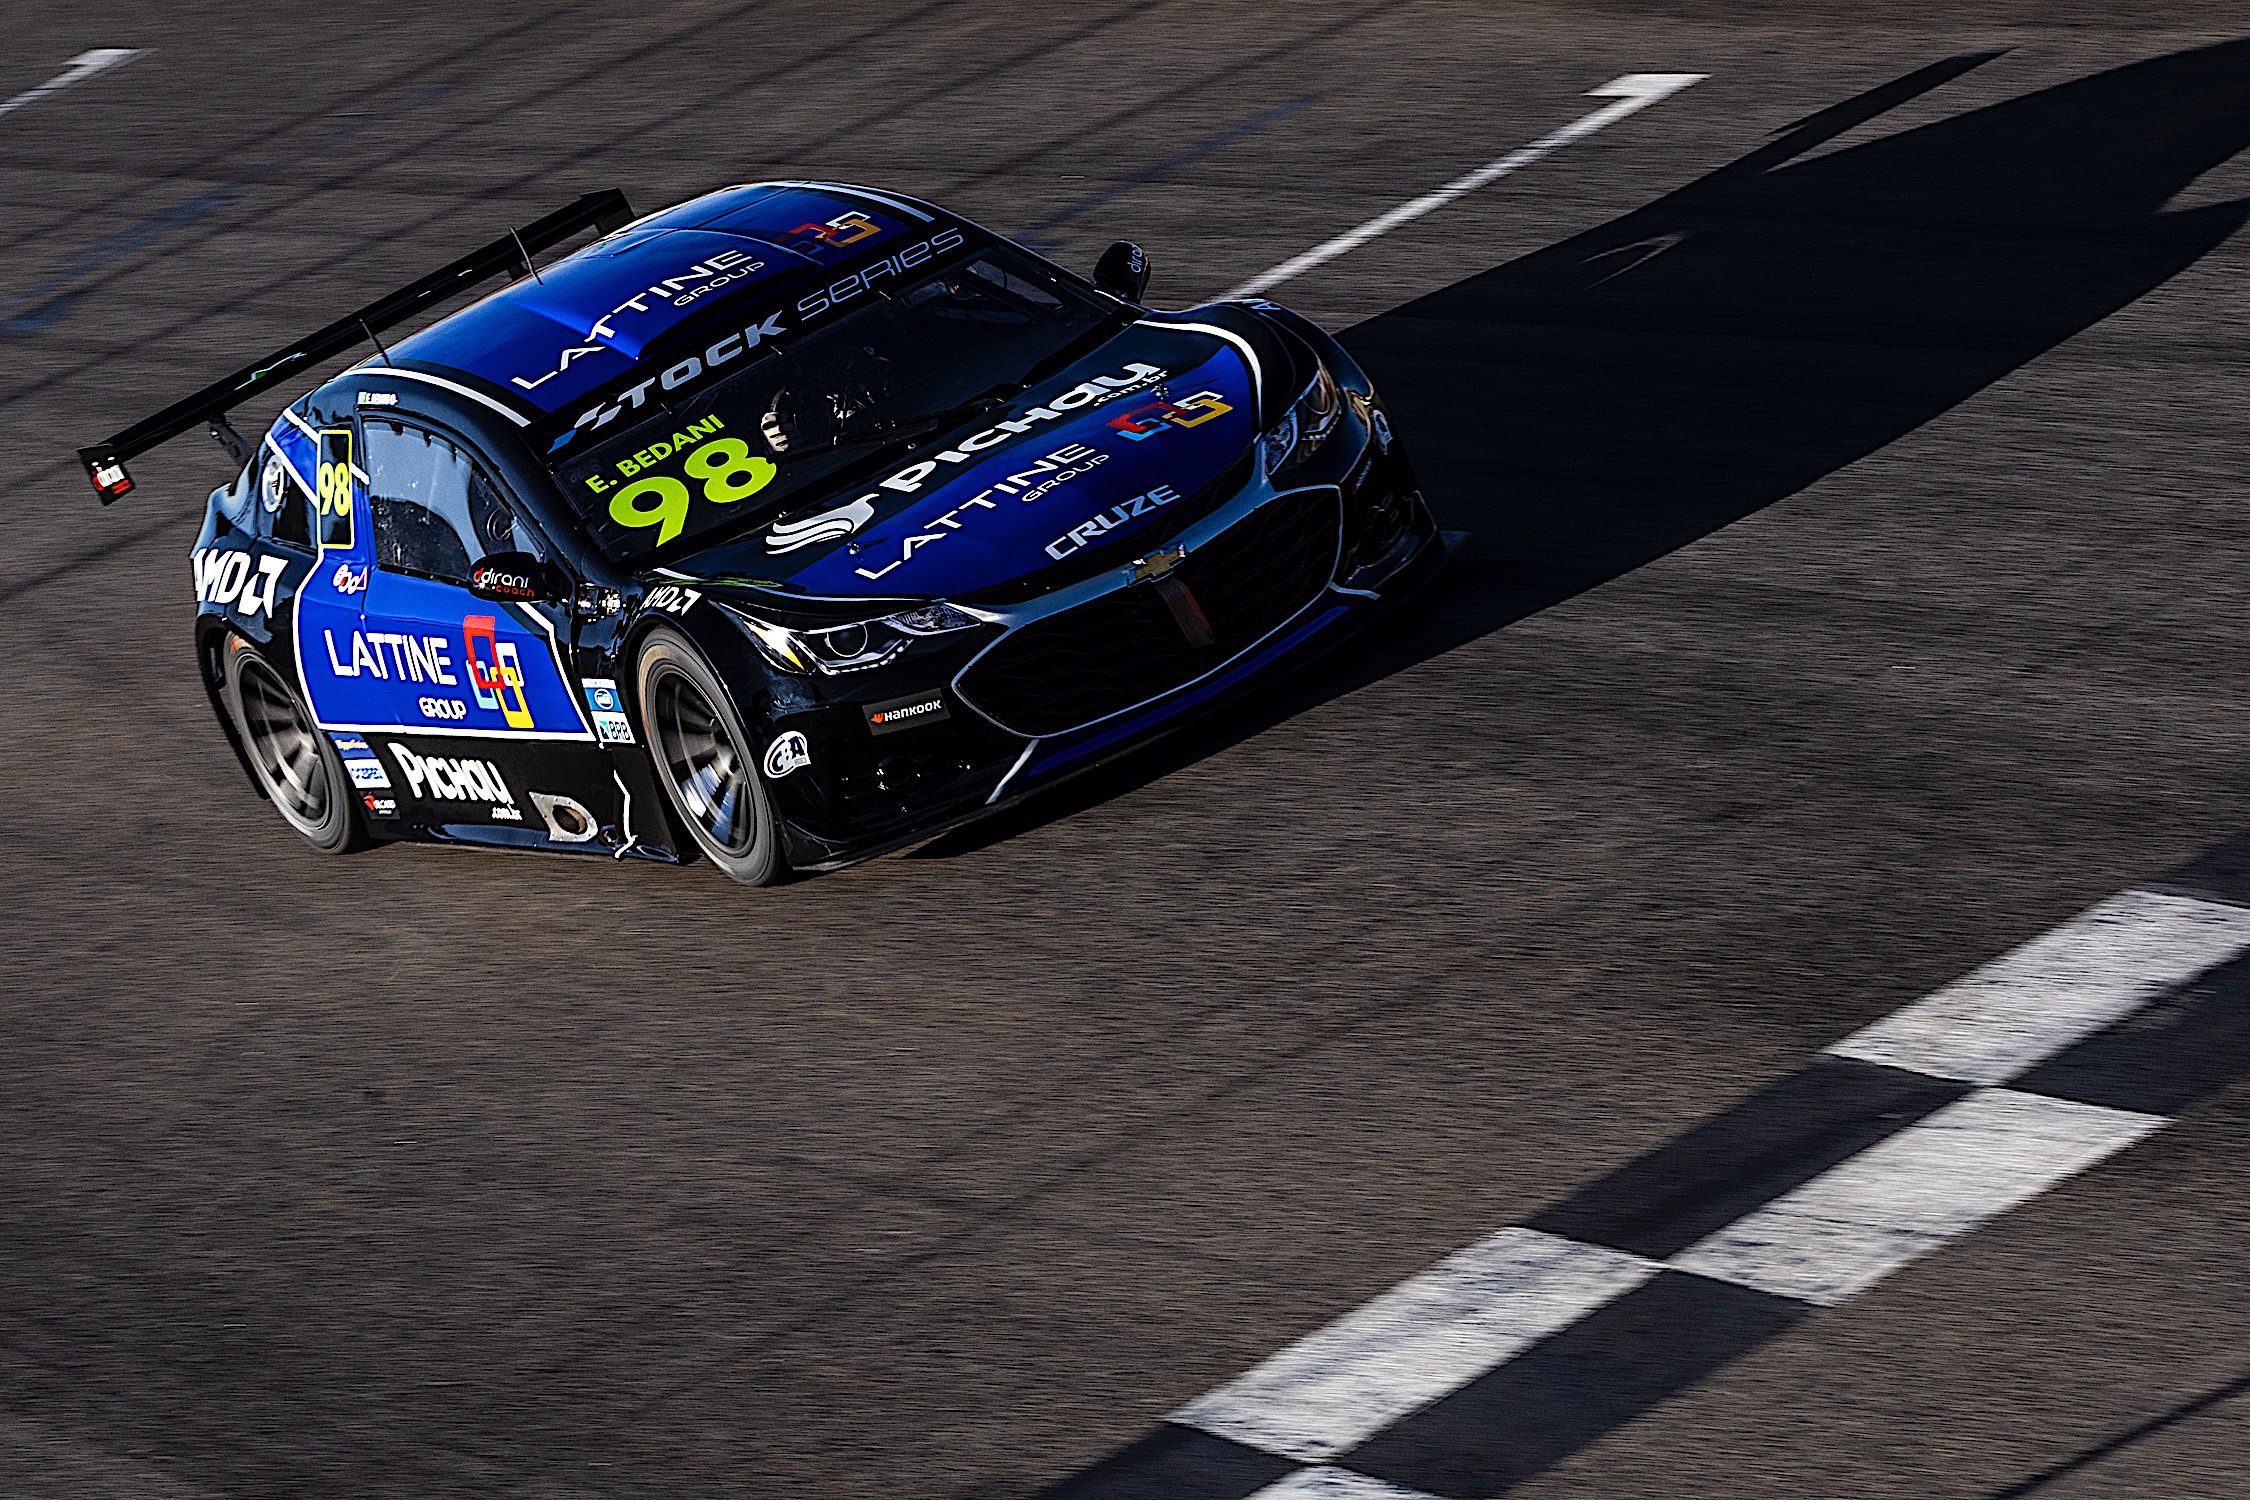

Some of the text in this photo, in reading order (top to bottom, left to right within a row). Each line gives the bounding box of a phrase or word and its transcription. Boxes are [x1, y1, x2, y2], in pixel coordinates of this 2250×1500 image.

[673, 260, 765, 307] GROUP
[511, 249, 753, 390] LATTINE
[547, 310, 786, 454] STOCK
[585, 474, 618, 494] E.
[616, 414, 725, 477] BEDANI
[1021, 452, 1110, 503] GROUP
[319, 462, 351, 516] 98
[609, 437, 777, 547] 98
[854, 443, 1096, 580] LATTINE
[1045, 484, 1181, 561] CRUZE
[496, 585, 535, 598] coach
[324, 629, 457, 685] LATTINE
[418, 696, 467, 721] GROUP
